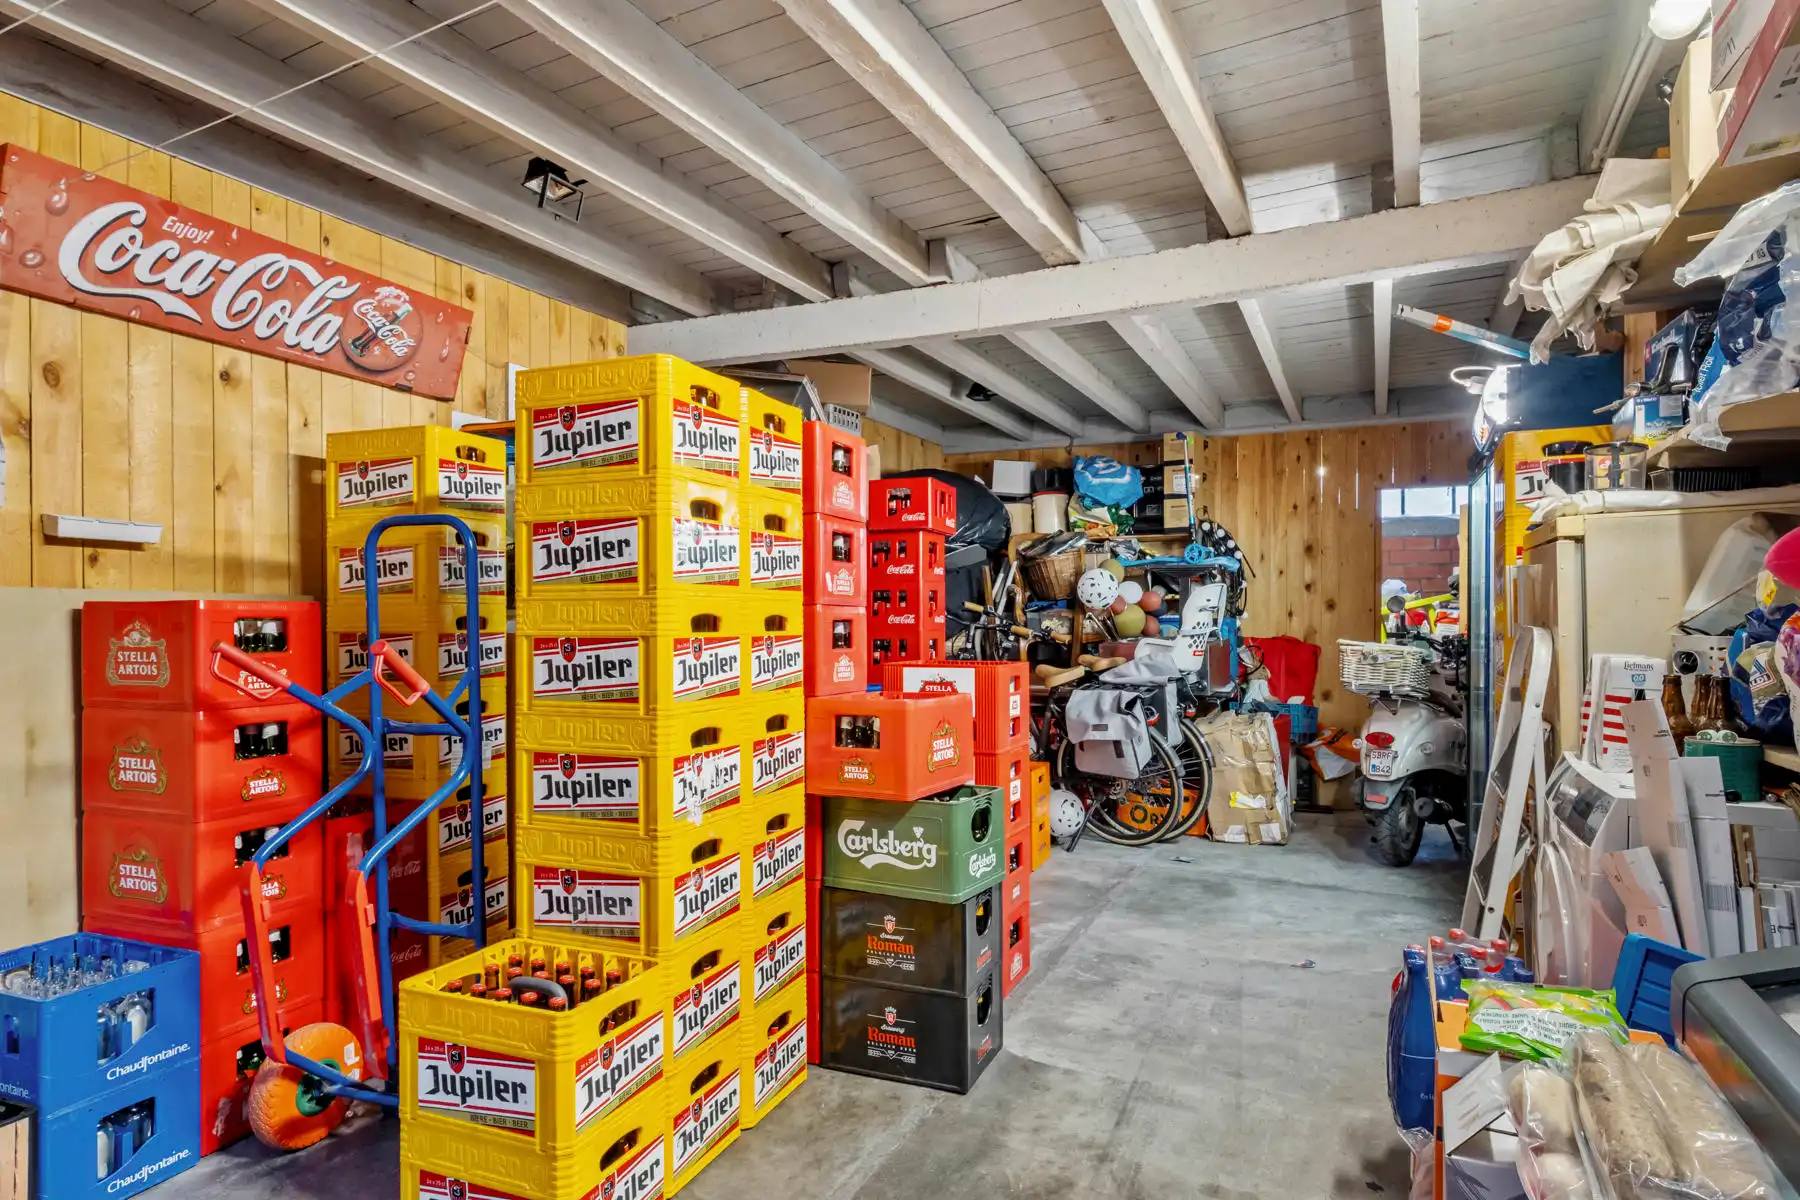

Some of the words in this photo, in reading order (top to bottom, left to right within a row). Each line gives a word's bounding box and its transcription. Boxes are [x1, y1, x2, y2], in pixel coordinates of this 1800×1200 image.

[162, 216, 214, 244] Enjoy!
[58, 201, 360, 355] Coca-Cola
[352, 300, 412, 358] Coca-Cola
[540, 420, 631, 457] Jupiler
[678, 422, 736, 456] Jupiler
[753, 447, 799, 474] Jupiler
[344, 472, 408, 499] Jupiler
[444, 475, 502, 498] Jupiler
[540, 536, 631, 571] Jupiler
[754, 550, 799, 576] Jupiler
[344, 559, 408, 584] Juiler
[444, 558, 502, 583] Juler
[117, 651, 157, 662] STELLA
[118, 664, 158, 675] ARTOIS
[443, 645, 502, 668] Juler
[678, 652, 737, 686] Jupiler
[755, 649, 800, 679] Jupiler
[541, 654, 632, 689] Jupiler
[344, 733, 408, 755] Juler
[933, 737, 954, 750] STELLA
[933, 748, 954, 762] ARTOIS
[118, 757, 156, 770] STELLA
[118, 769, 157, 783] ARTOIS
[756, 747, 802, 782] Jupiler
[250, 777, 278, 788] STELLA
[250, 784, 279, 795] ARTOIS
[540, 773, 631, 805] Jupiler
[443, 809, 503, 843] Juper
[838, 819, 937, 870] Carlsberg
[119, 864, 156, 879] STELLA
[756, 844, 801, 887] Jupiler
[969, 849, 996, 878] Carlsberg
[119, 877, 157, 892] ARTOIS
[679, 872, 737, 924] Jupiler
[446, 891, 504, 924] Juper
[541, 889, 632, 921] Jupiler
[867, 935, 915, 955] Roman
[758, 940, 802, 991] Jupiler
[678, 980, 736, 1043] Jupiler
[867, 1026, 916, 1048] Roman
[580, 1033, 660, 1116] Jupiler
[758, 1036, 804, 1095] Jupiler
[425, 1064, 527, 1106] Jupiler
[512, 1118, 528, 1128] BEER
[677, 1088, 737, 1162] Jupiler
[616, 1158, 660, 1199] iler
